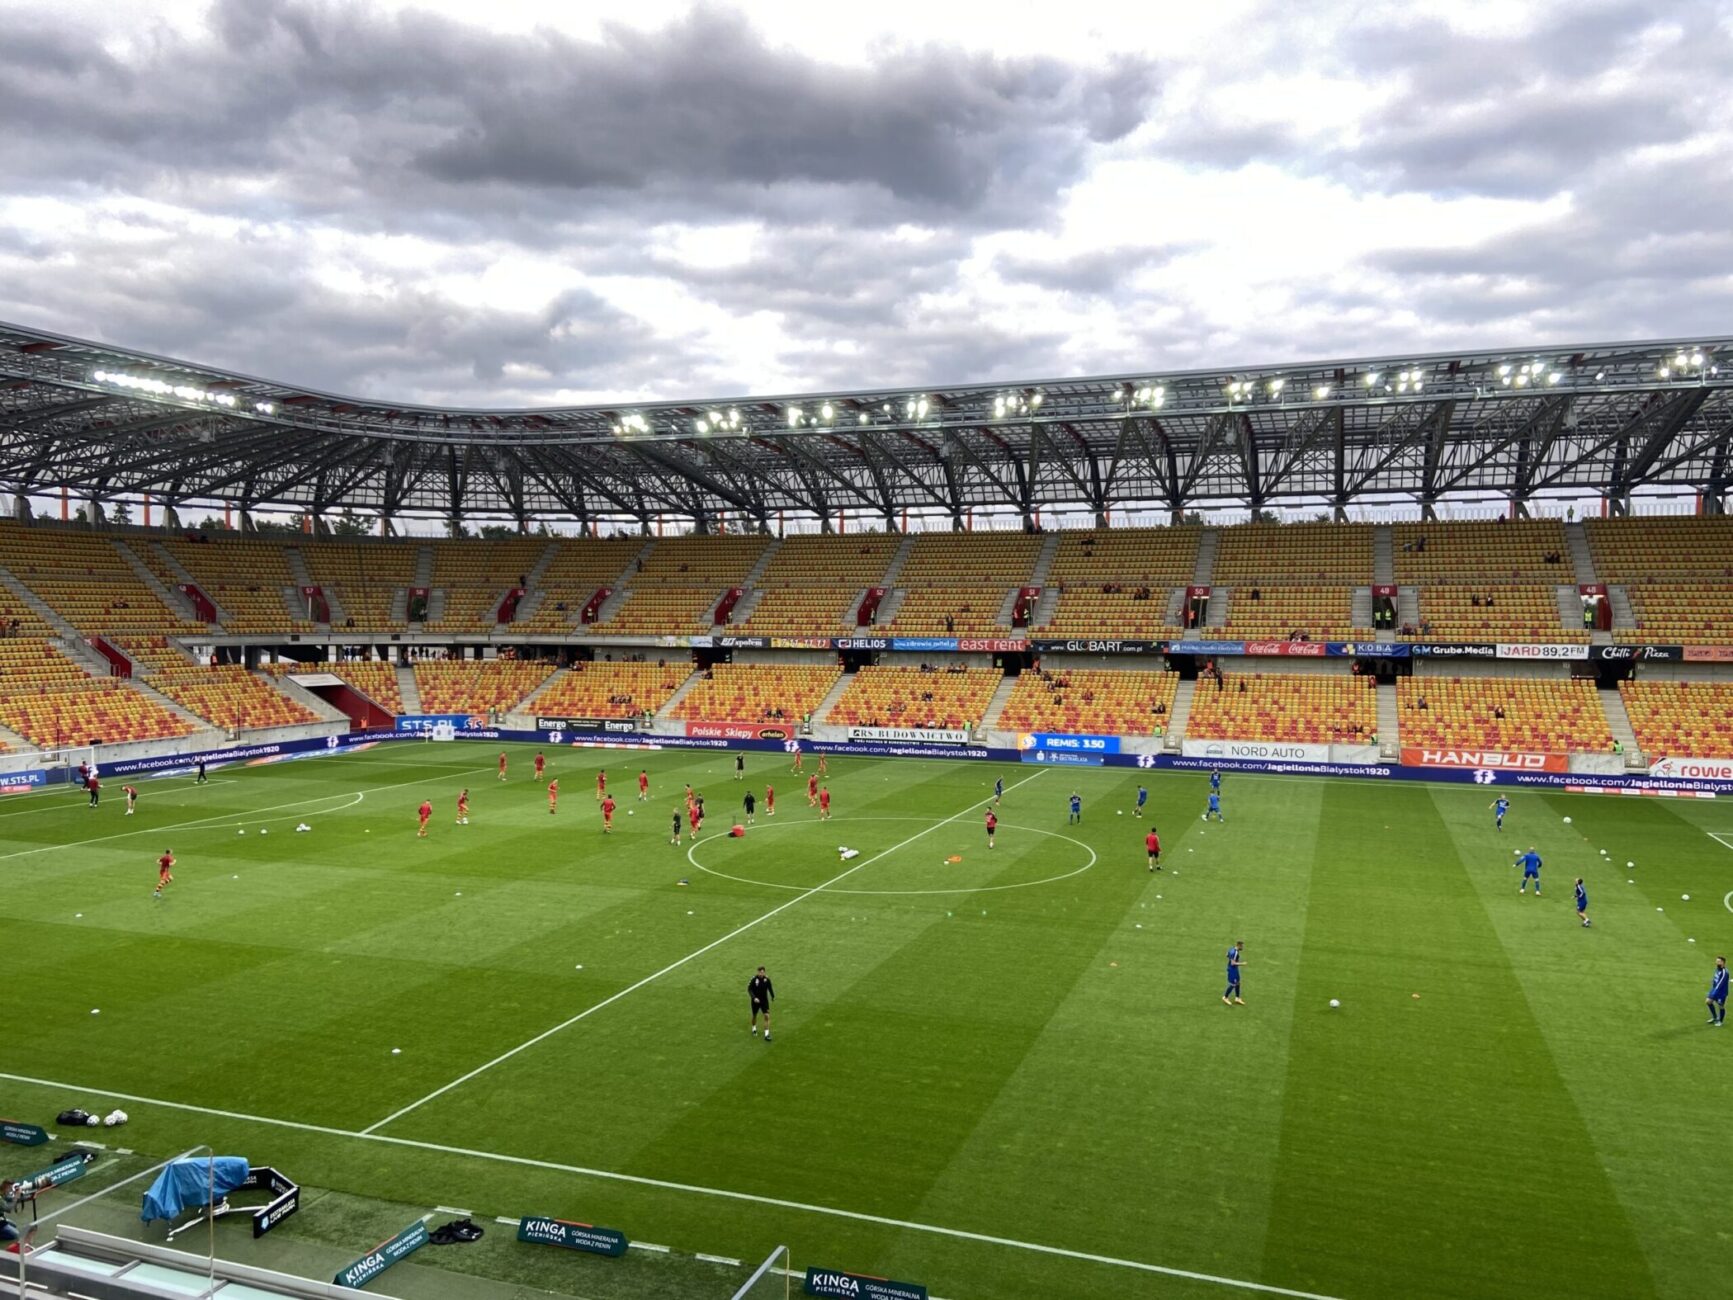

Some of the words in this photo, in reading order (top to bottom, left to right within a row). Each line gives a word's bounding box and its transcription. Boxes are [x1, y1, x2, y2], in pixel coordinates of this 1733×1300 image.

[853, 639, 886, 648] HELIOS
[961, 639, 989, 650] east
[994, 640, 1023, 651] rent
[1067, 641, 1122, 652] GLOBART
[1433, 646, 1494, 655] Grube.Media
[538, 719, 566, 729] Energo
[604, 721, 633, 731] Energo
[692, 727, 722, 736] Polskie
[725, 728, 753, 739] Sklepy
[860, 730, 873, 738] RS
[878, 729, 963, 741] BUDOWNICTWO
[1046, 738, 1080, 747] REMIS:
[1083, 739, 1105, 748] 3.50
[1232, 745, 1268, 757] NORD
[1272, 747, 1304, 759] AUTO
[1422, 750, 1546, 768] HANBUD
[1681, 764, 1732, 778] rowe
[1517, 775, 1733, 792] www.facebook.com/JagielloniaBialyst
[526, 1221, 566, 1238] KINGA
[527, 1231, 562, 1242] PIENIŃSKA
[571, 1230, 591, 1240] GÓRSKA
[590, 1234, 618, 1244] MINERALNA
[575, 1238, 591, 1247] WODA
[594, 1242, 611, 1250] PIENIN
[345, 1252, 385, 1283] KINGA
[812, 1273, 860, 1293] KINGA
[815, 1286, 856, 1298] PIENIŃSKA
[865, 1284, 888, 1294] GÓRSKA
[888, 1288, 920, 1300] MINERALNA
